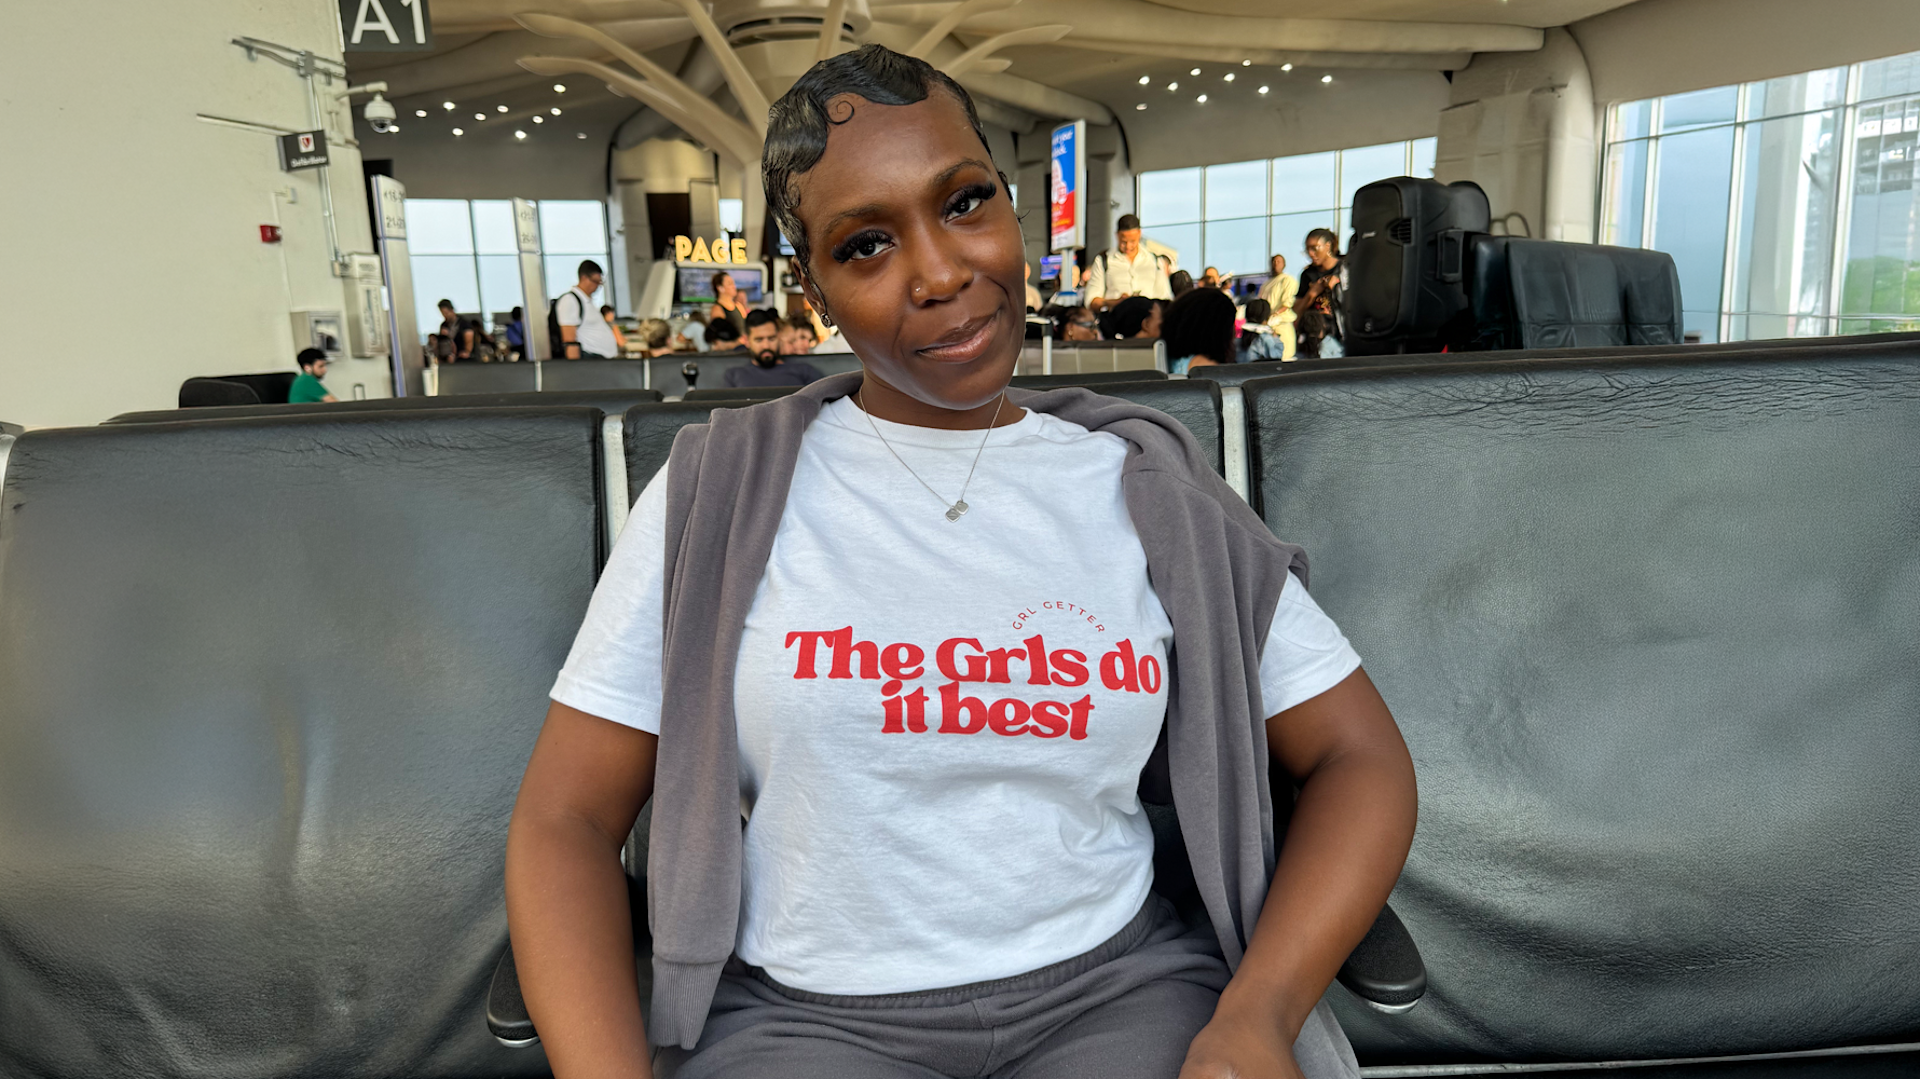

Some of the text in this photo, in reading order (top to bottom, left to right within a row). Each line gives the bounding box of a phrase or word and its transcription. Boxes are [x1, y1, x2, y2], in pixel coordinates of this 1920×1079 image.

[350, 0, 427, 44] A1
[675, 235, 748, 264] PAGE
[1012, 601, 1105, 632] GRL GETTER
[784, 625, 1161, 695] The Grls do
[880, 680, 1096, 741] it best
